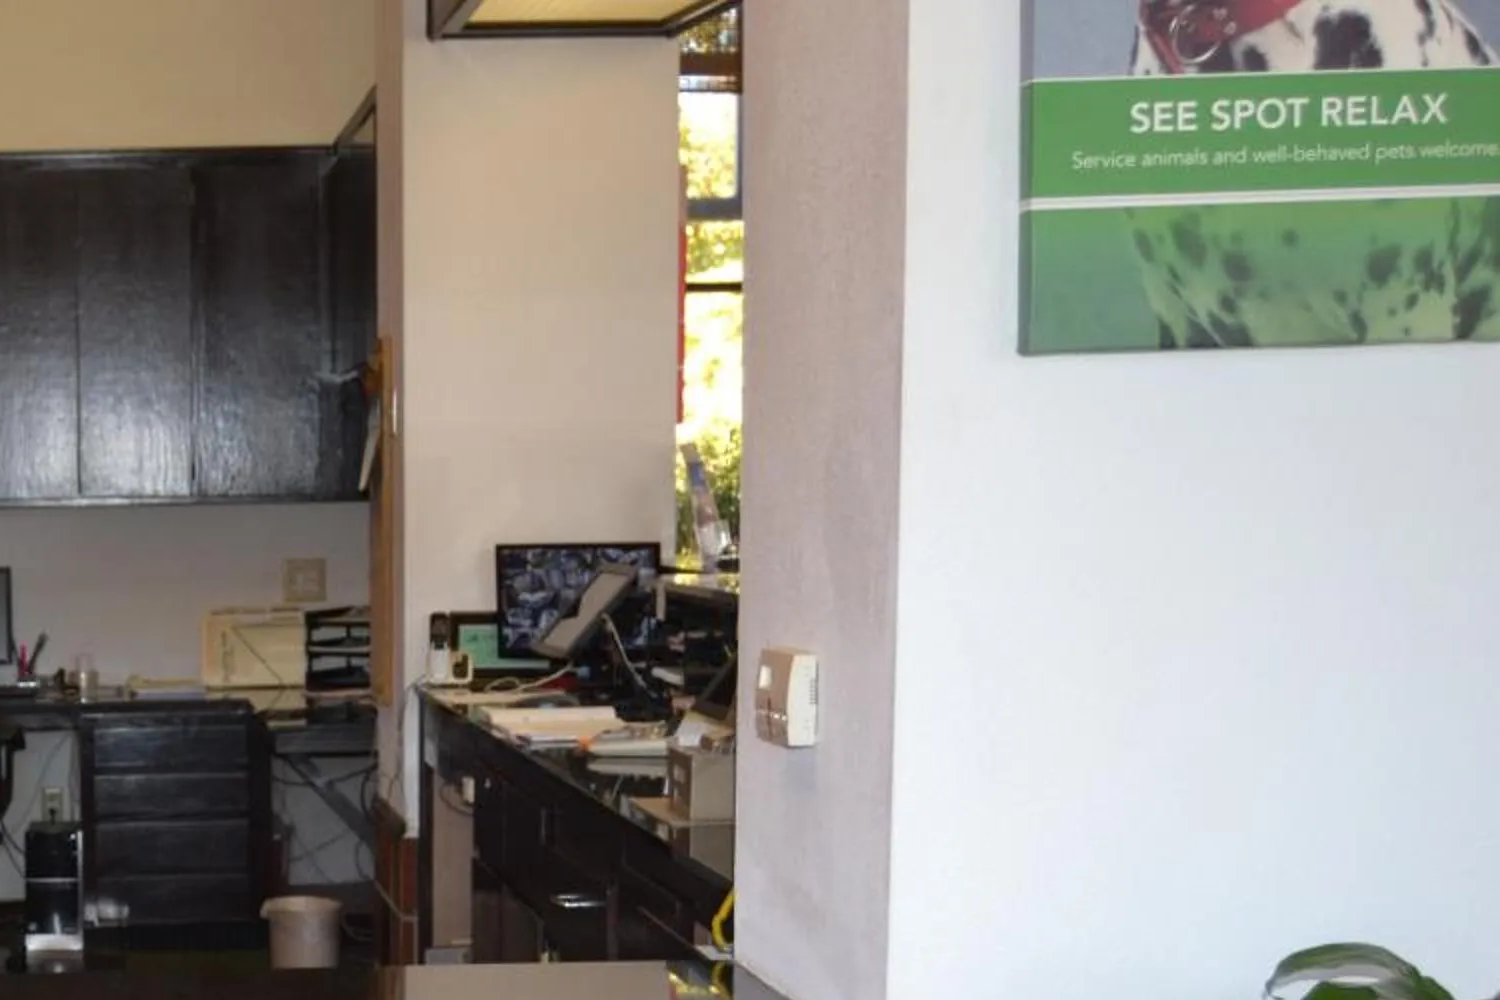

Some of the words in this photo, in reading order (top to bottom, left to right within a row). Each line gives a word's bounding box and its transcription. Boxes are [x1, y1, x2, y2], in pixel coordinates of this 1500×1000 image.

[1129, 99, 1198, 134] SEE
[1209, 97, 1311, 131] SPOT
[1320, 92, 1449, 128] RELAX
[1071, 149, 1137, 170] Service
[1140, 147, 1209, 168] animals
[1212, 145, 1248, 165] and
[1252, 143, 1370, 164] well-behaved
[1374, 143, 1414, 167] pets
